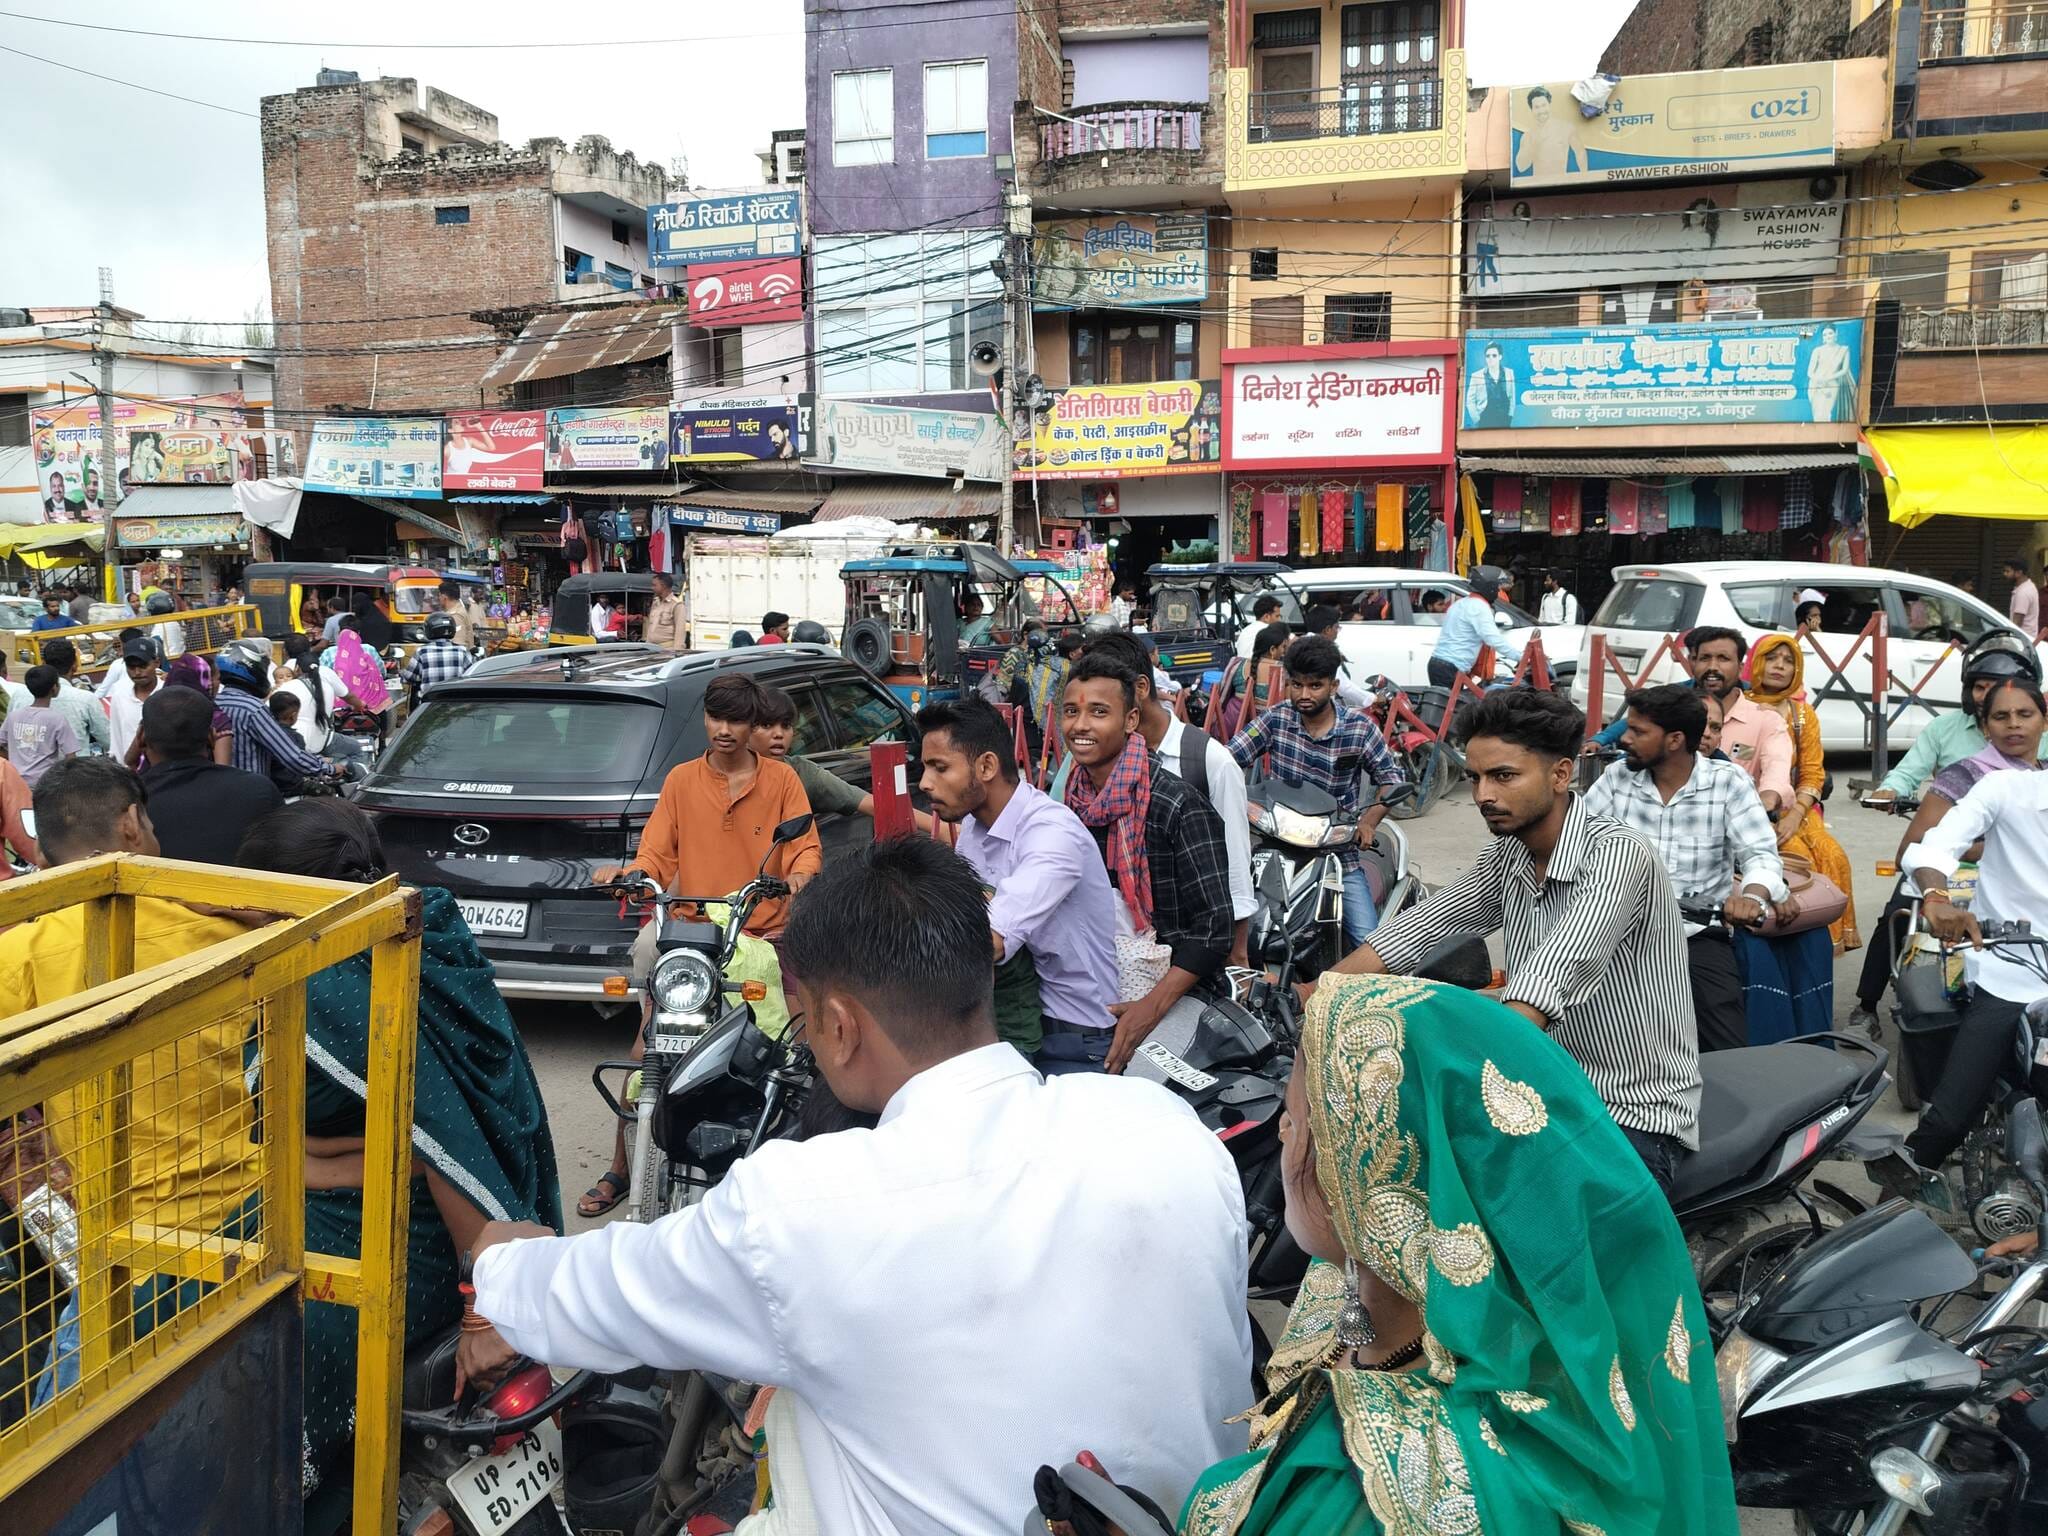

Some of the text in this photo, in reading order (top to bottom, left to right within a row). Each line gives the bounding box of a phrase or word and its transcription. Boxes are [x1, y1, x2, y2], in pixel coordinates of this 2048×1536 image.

[1750, 89, 1810, 120] cozi
[1608, 113, 1655, 132] मुस्कान
[1692, 129, 1797, 143] VESTS BRIEFS DRAWERS
[1607, 162, 1729, 181] SWAMVER FASHION
[653, 207, 695, 232] दीपक
[747, 198, 791, 222] सेन्टर
[1743, 206, 1838, 222] SWAYAMVAR
[1757, 223, 1820, 236] FASHION
[1762, 238, 1811, 251] HOUSE
[1089, 253, 1200, 298] ब्यूटी पार्लर
[729, 281, 752, 293] airtel
[729, 293, 753, 303] Wi-Fi
[1241, 367, 1442, 408] दिनेश ट्रेडिंग कम्पनी
[699, 398, 767, 409] दीपक मेडिकल स्टोर
[1054, 391, 1142, 421] डेलिशियस
[1146, 388, 1195, 416] बेकरी
[1626, 404, 1701, 420] बादशाहपुर,
[1706, 402, 1757, 420] जौनपुर
[56, 425, 87, 441] स्वतंत्रता
[89, 423, 103, 441] दिव
[695, 419, 730, 428] NIMULID
[736, 418, 760, 432] गर्दन
[835, 412, 915, 448] कुमकुम
[946, 422, 976, 440] सेन्टर
[1053, 426, 1079, 441] केक,
[1114, 422, 1167, 438] आइसक्रीम
[1241, 432, 1270, 442] लहंगा
[1287, 429, 1314, 443] सूटिंग
[165, 437, 209, 456] श्रद्धा
[1070, 447, 1098, 461] कोल्ड
[1101, 446, 1122, 463] ड्रिंक
[1126, 449, 1132, 459] व
[467, 475, 516, 489] लकी बेकरी
[673, 506, 777, 528] दीपक मेडिकल स्टोर
[477, 784, 513, 794] HYUNDAI
[426, 850, 521, 863] VENUE
[1821, 1105, 1850, 1130] N160
